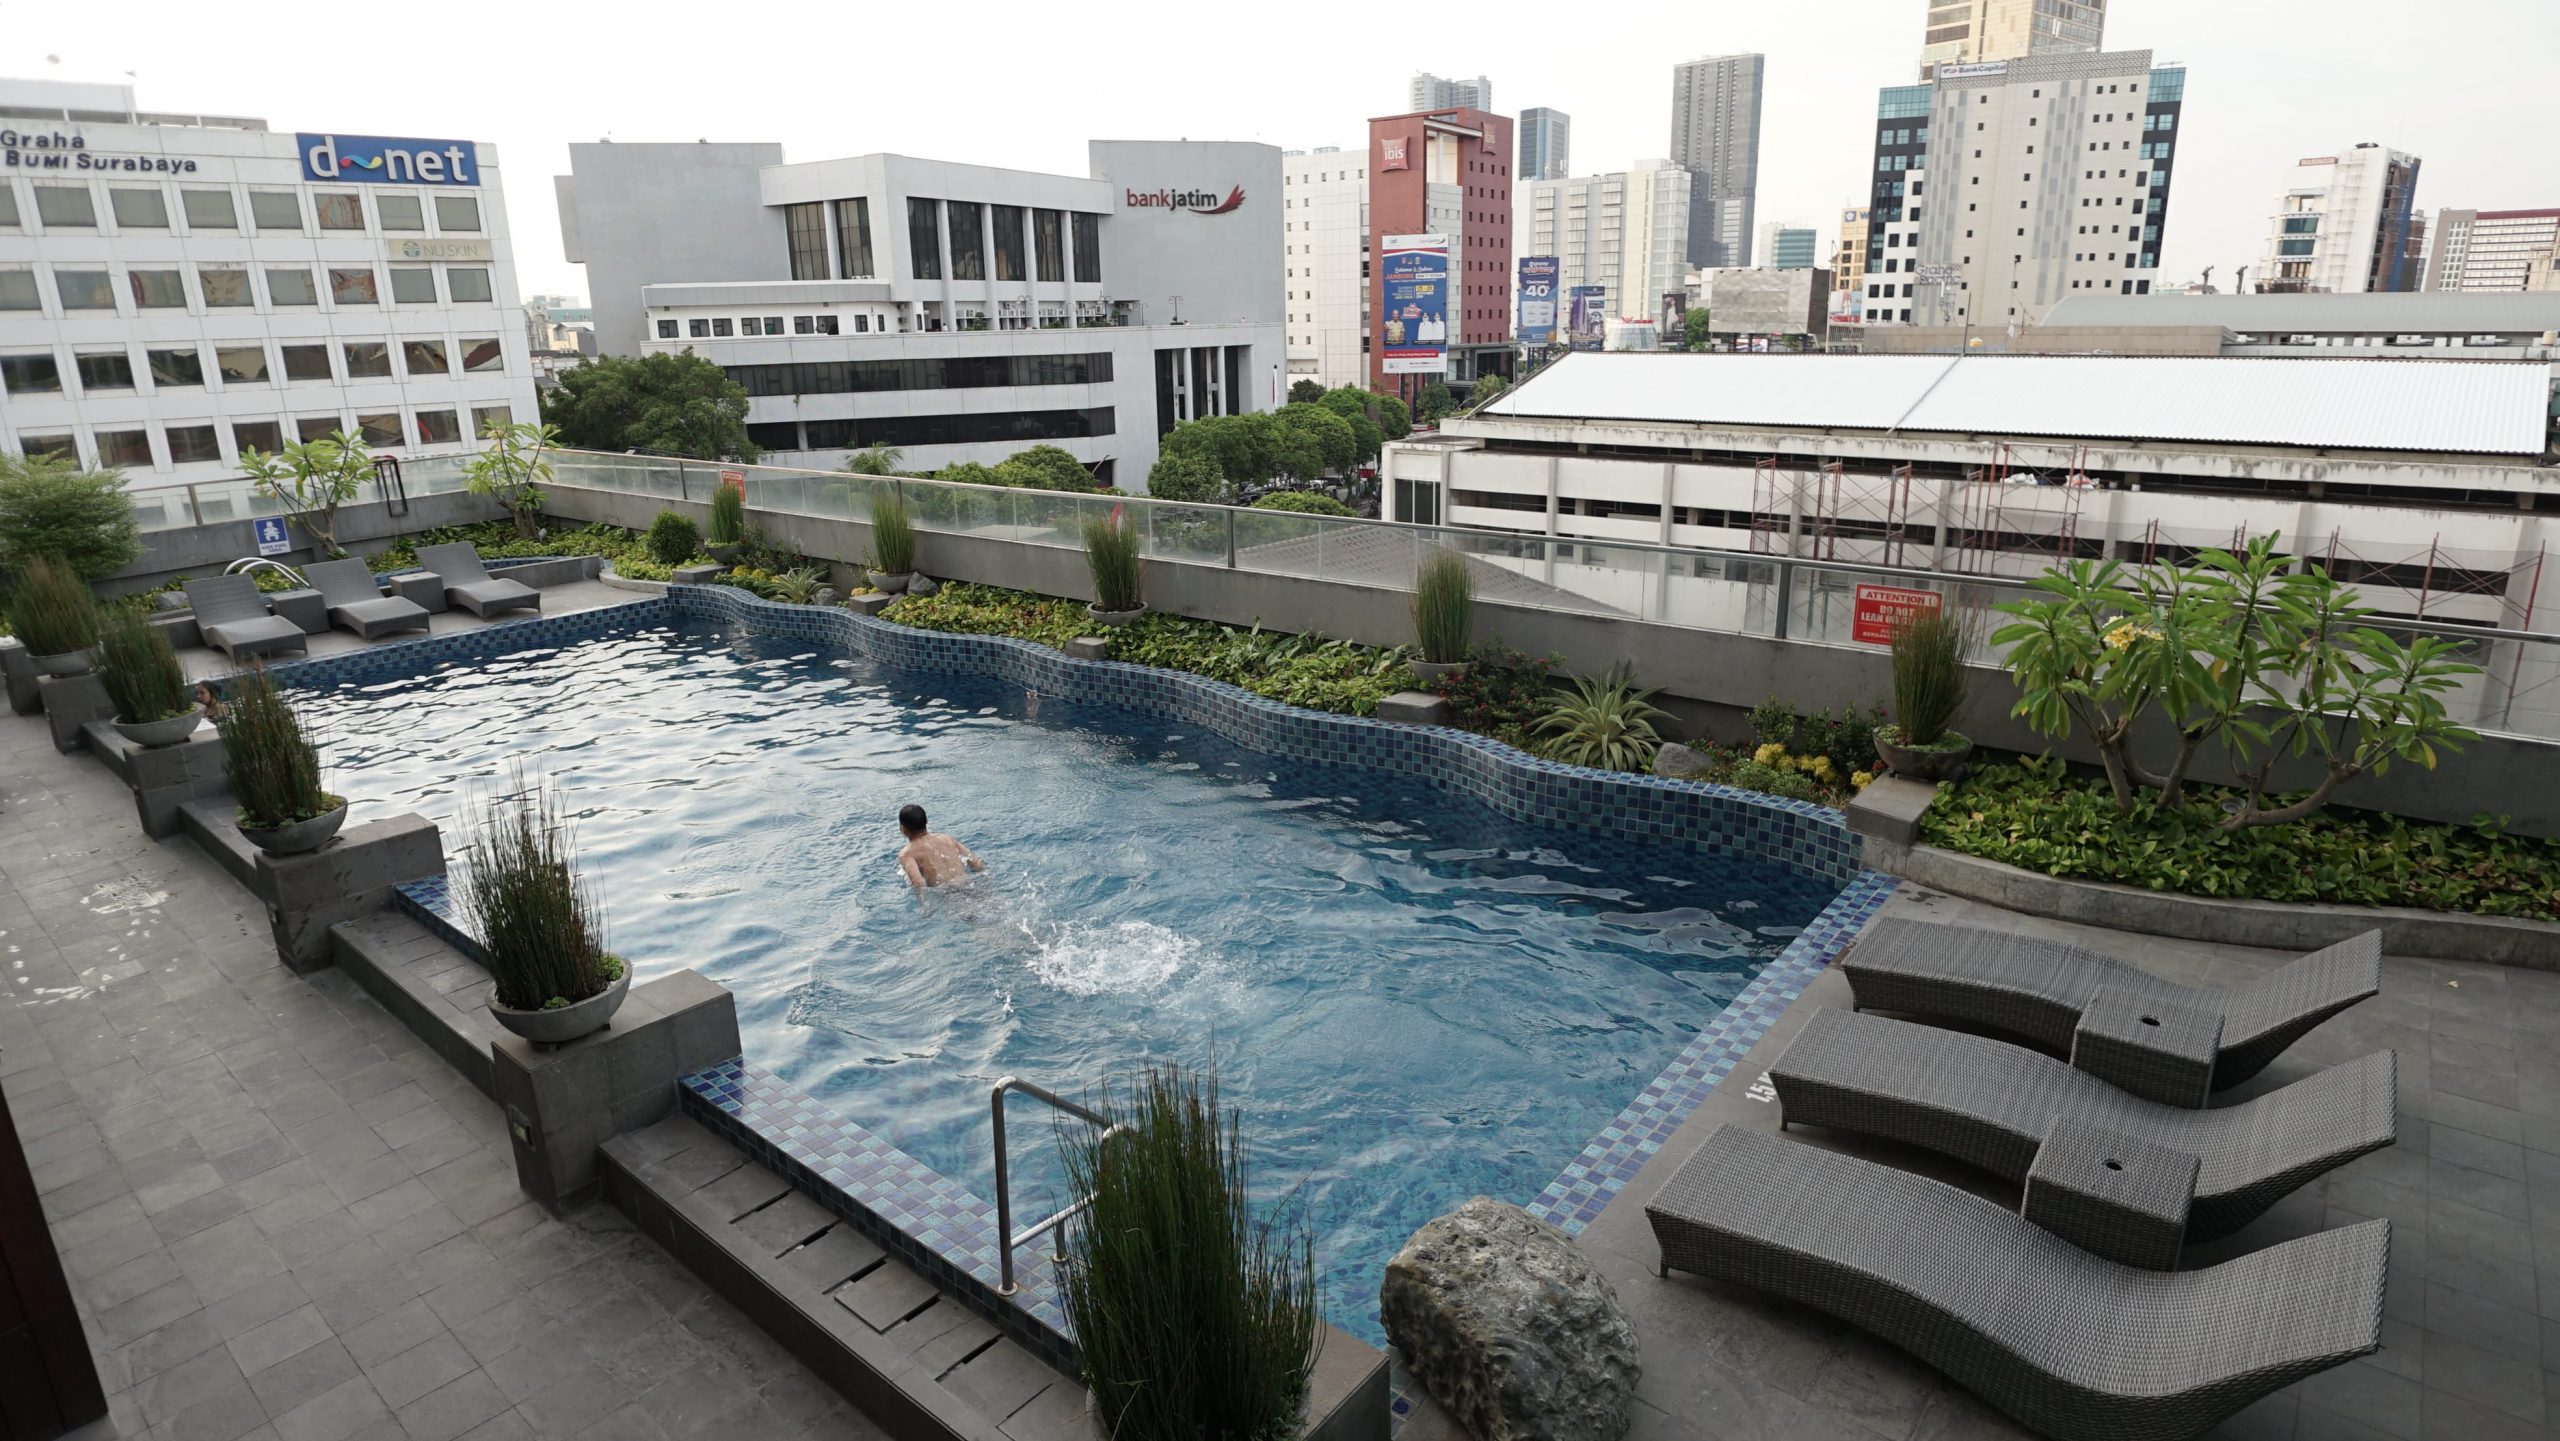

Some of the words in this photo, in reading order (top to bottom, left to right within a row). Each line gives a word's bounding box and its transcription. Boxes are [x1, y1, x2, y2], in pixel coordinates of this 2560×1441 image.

[0, 130, 85, 149] Graha
[1384, 147, 1404, 160] ibis
[77, 153, 196, 174] Surabaya
[1126, 188, 1218, 212] bankjatim
[422, 245, 444, 257] NU
[447, 245, 478, 257] SKIN
[1866, 591, 1925, 605] ATTENTION
[1861, 612, 1884, 623] LEAN
[1880, 605, 1892, 615] DO
[1895, 606, 1915, 617] NOT
